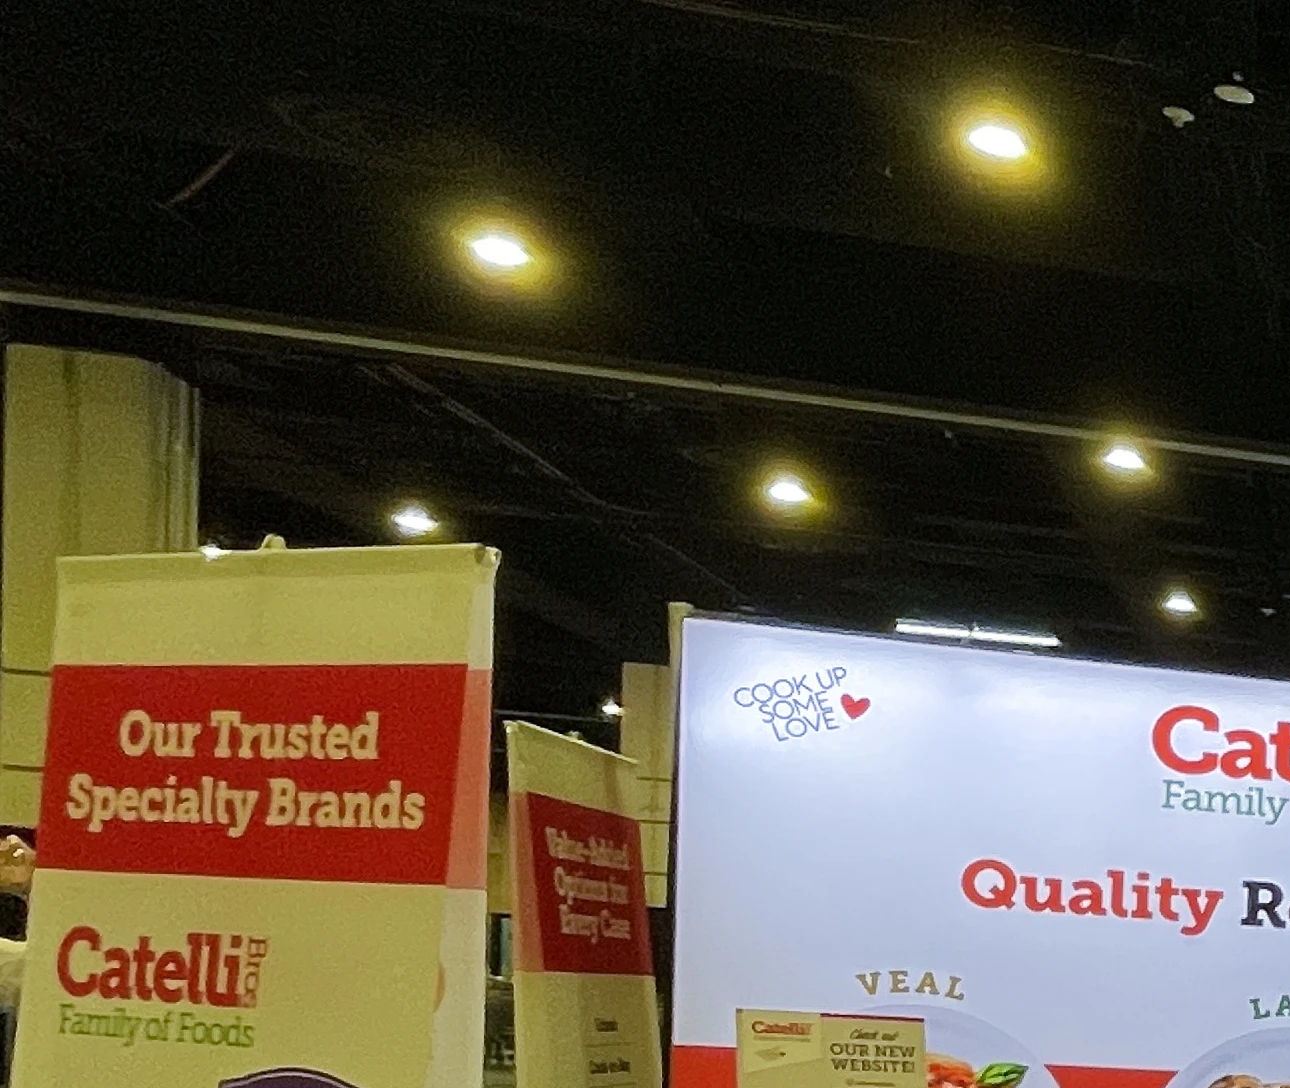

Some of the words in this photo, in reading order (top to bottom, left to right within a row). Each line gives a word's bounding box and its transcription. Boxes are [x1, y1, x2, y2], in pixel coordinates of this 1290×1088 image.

[734, 674, 813, 707] COOK
[816, 667, 846, 690] UP
[759, 690, 832, 723] SOME
[119, 710, 199, 758] Our
[210, 711, 379, 760] Trusted
[772, 709, 841, 742] LOVE
[66, 774, 259, 838] Specialty
[266, 778, 426, 831] Brands
[1161, 779, 1290, 826] Family
[961, 859, 1224, 936] Quality
[57, 926, 243, 1008] Catelli
[243, 935, 268, 1008] Bros
[856, 969, 965, 1000] VEAL
[59, 1003, 142, 1046] Family
[144, 1011, 173, 1041] of
[175, 1012, 256, 1047] Foods
[830, 1043, 869, 1056] OUR
[876, 1045, 916, 1058] NEW
[831, 1058, 915, 1073] WEBSITE!
